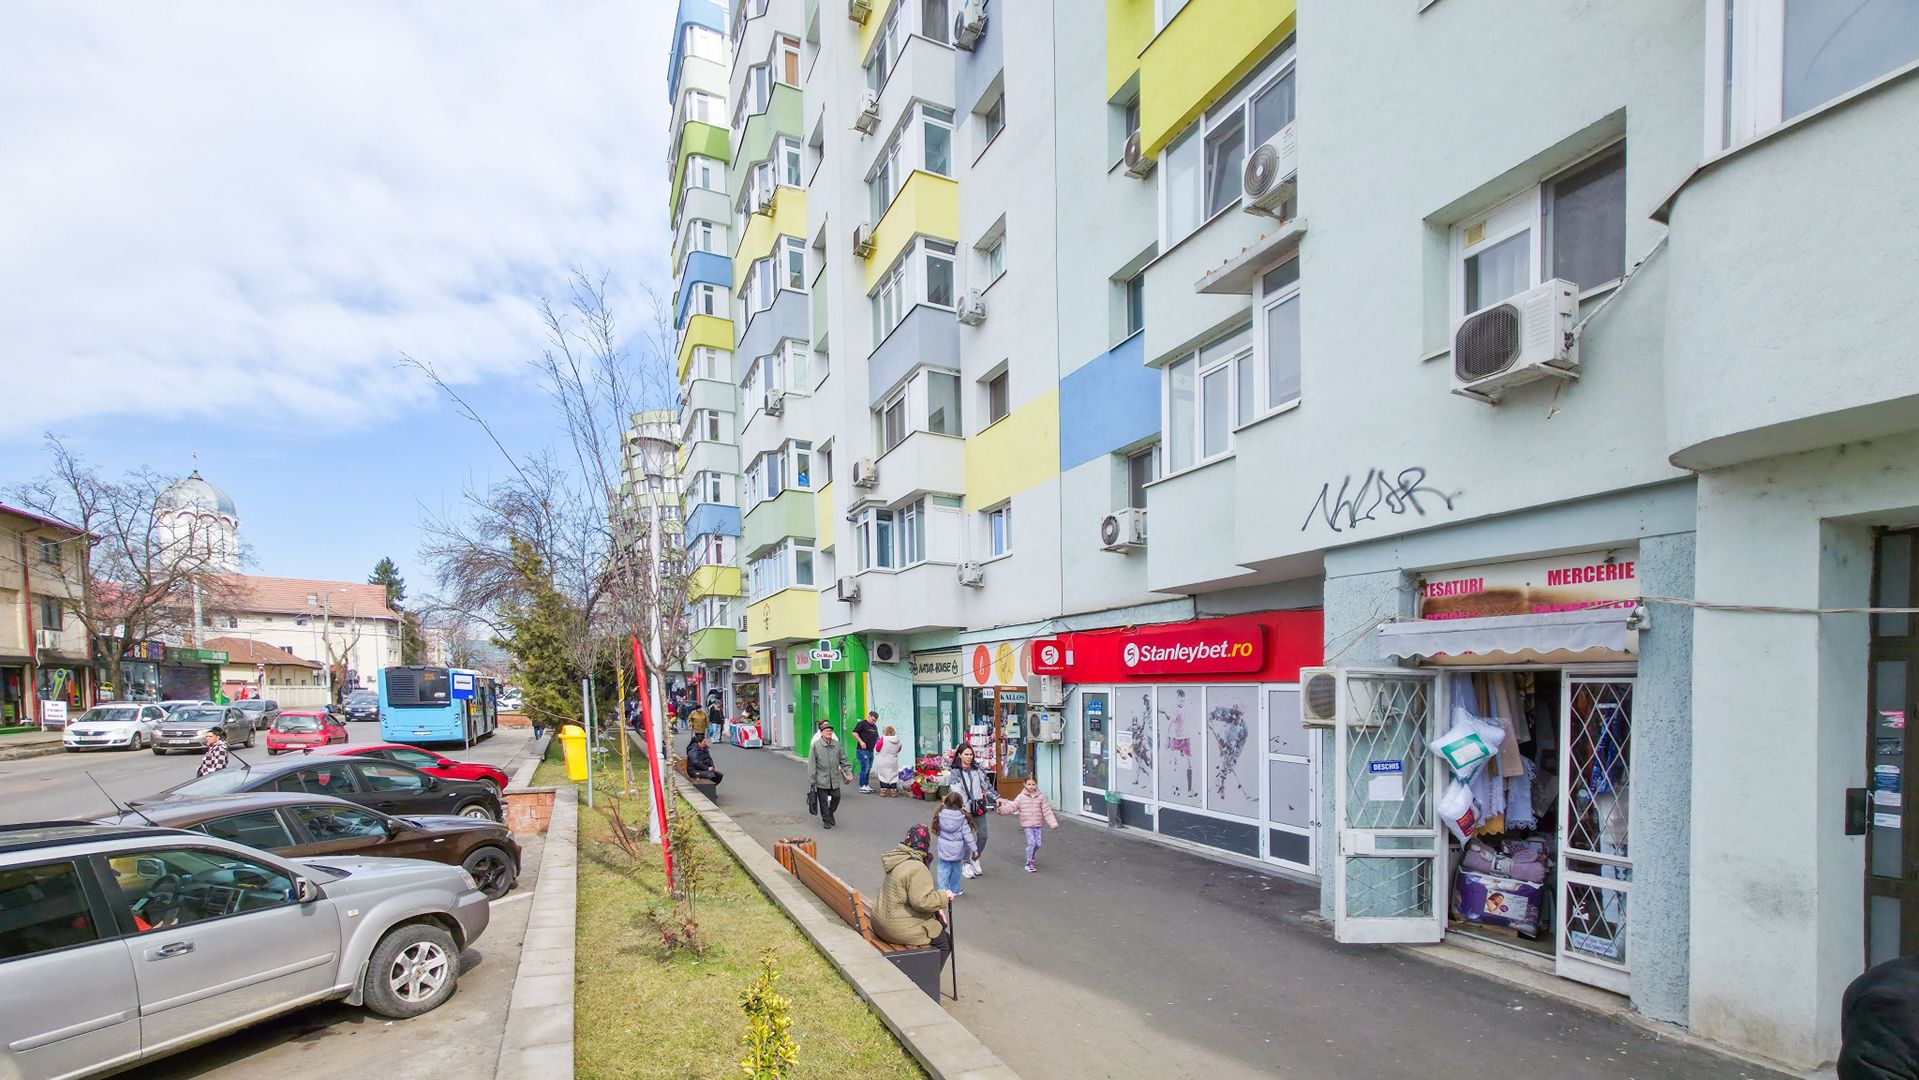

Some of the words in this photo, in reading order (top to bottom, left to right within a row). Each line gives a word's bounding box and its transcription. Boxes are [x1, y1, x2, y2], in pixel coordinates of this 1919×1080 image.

[1547, 562, 1635, 586] MERCERIE
[1424, 578, 1484, 598] TESATURI
[1140, 641, 1253, 663] Stanleybet.ro
[1372, 762, 1400, 770] DESCHIS
